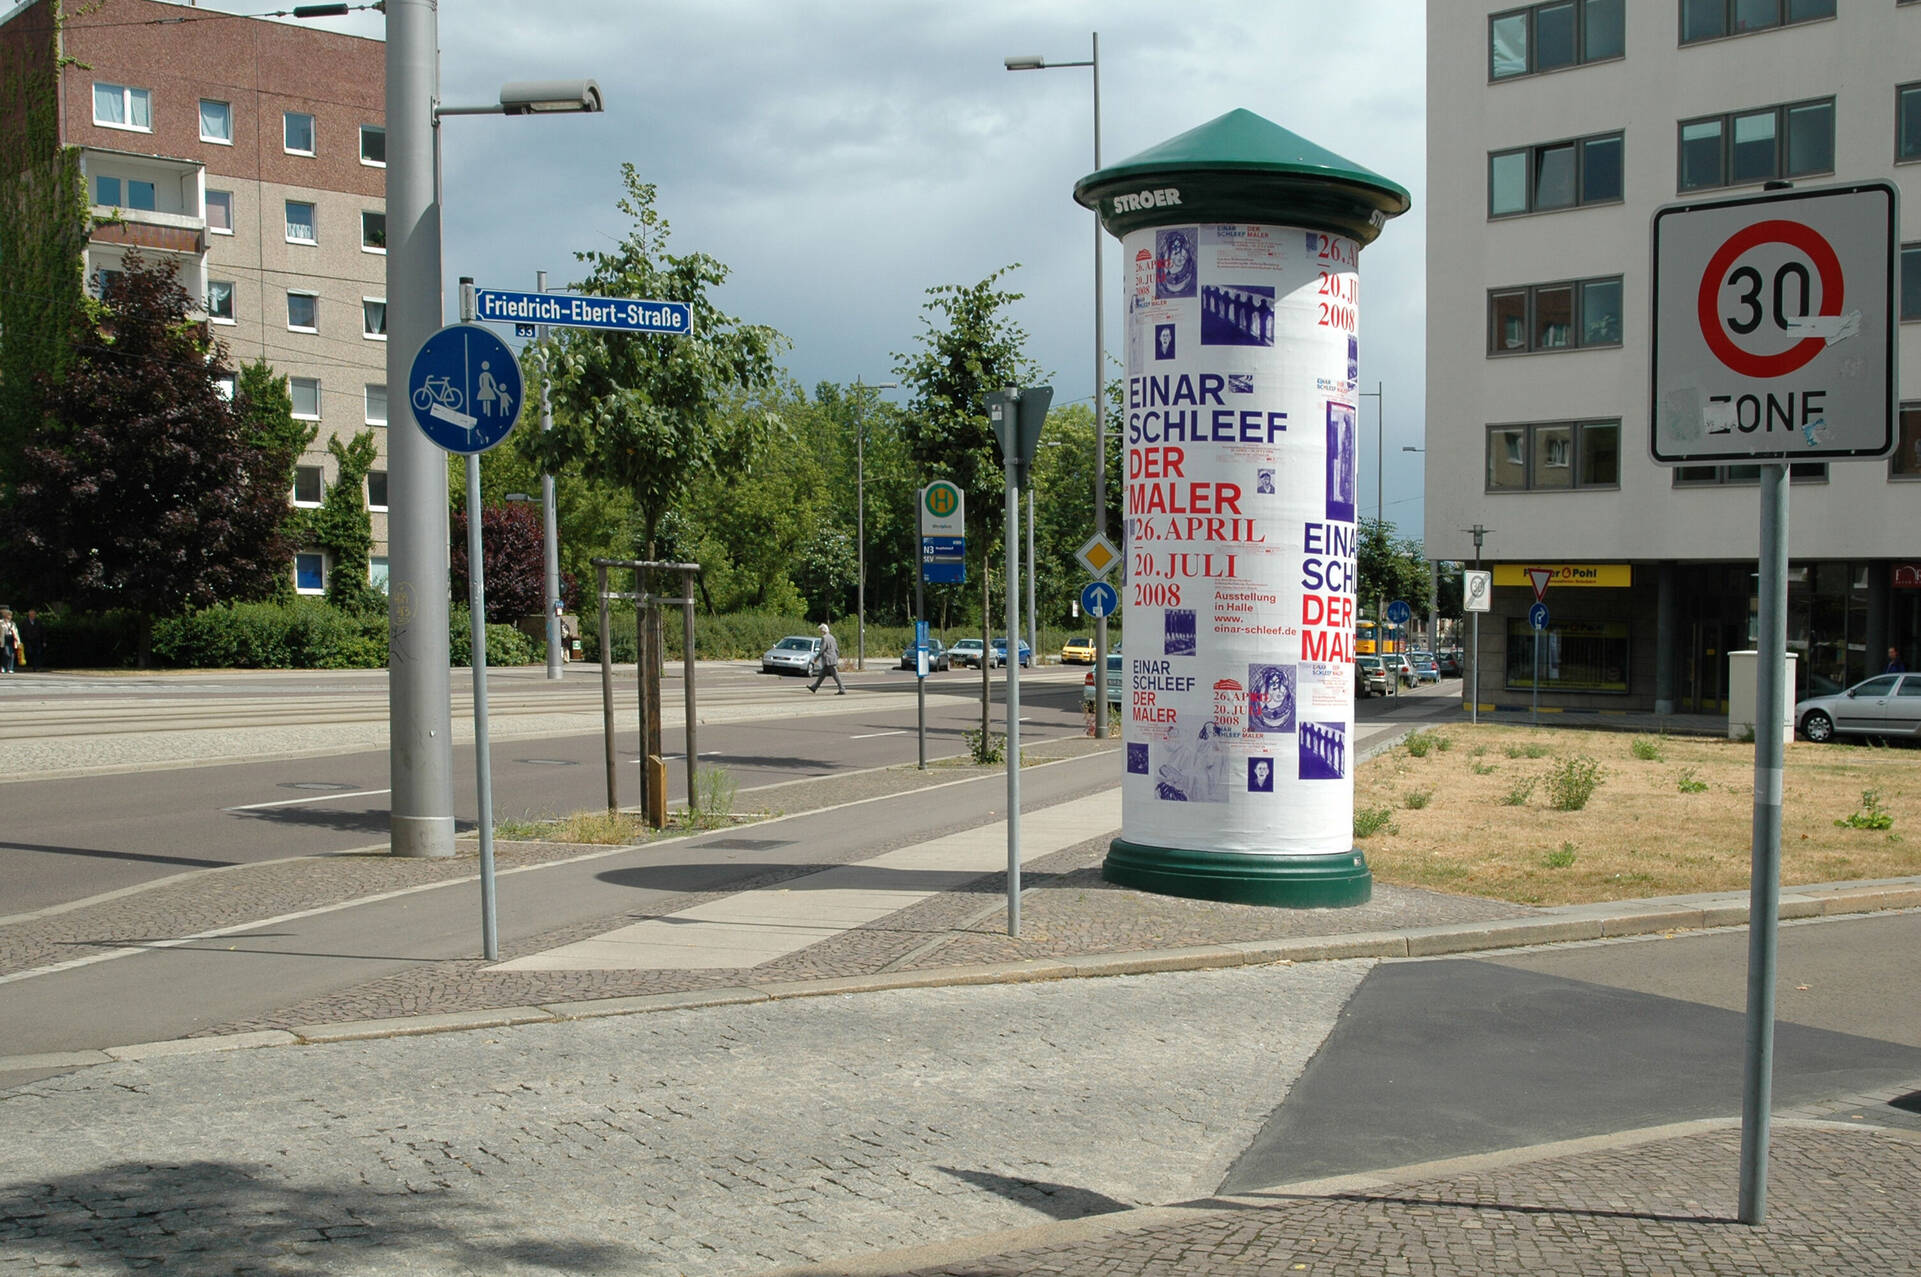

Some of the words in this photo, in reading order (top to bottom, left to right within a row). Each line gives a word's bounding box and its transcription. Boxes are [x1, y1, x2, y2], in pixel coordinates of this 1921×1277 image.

[1727, 261, 1811, 335] 30
[485, 294, 682, 328] Friedrich-Ebert-Straße
[1318, 302, 1356, 333] 2008
[517, 325, 534, 338] 33
[1130, 373, 1226, 409] EINAR
[1129, 410, 1288, 445] SCHLEEF
[1130, 446, 1185, 480] DER
[1129, 482, 1242, 515] MALER
[923, 545, 935, 555] N3
[1572, 568, 1598, 578] Pohl
[1133, 583, 1182, 608] 2008
[1214, 591, 1277, 604] Ausstellung
[1214, 602, 1225, 611] in
[1226, 602, 1254, 612] Halle
[1302, 593, 1353, 629] DER
[1214, 615, 1244, 623] www.
[1214, 624, 1297, 636] einar-schleef.de
[1133, 659, 1171, 675] EINAR
[1132, 675, 1196, 692] SCHLEEF
[1133, 691, 1156, 706] DER
[1132, 707, 1177, 723] MALER
[1213, 716, 1240, 726] 2008
